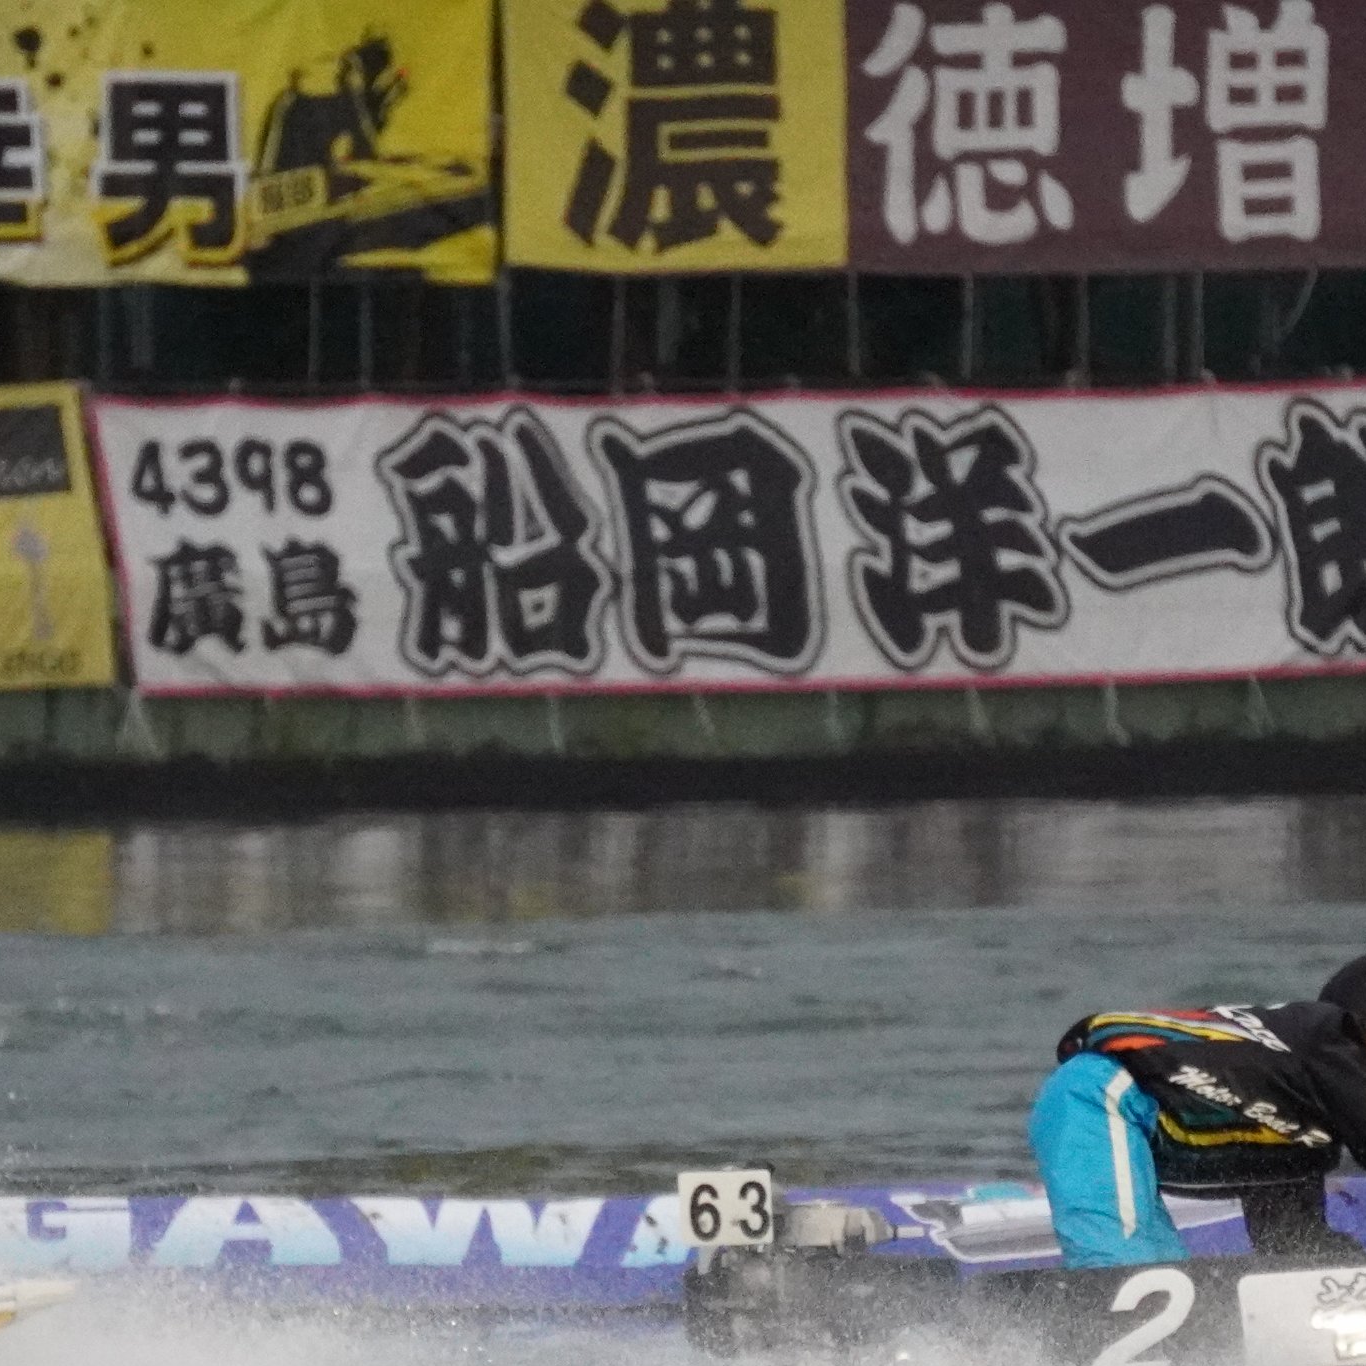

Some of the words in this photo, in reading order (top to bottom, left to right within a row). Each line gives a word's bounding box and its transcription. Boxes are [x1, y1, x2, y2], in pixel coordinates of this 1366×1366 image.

[134, 437, 335, 517] 4398
[148, 537, 358, 657] 廣島
[689, 1181, 771, 1242] 63
